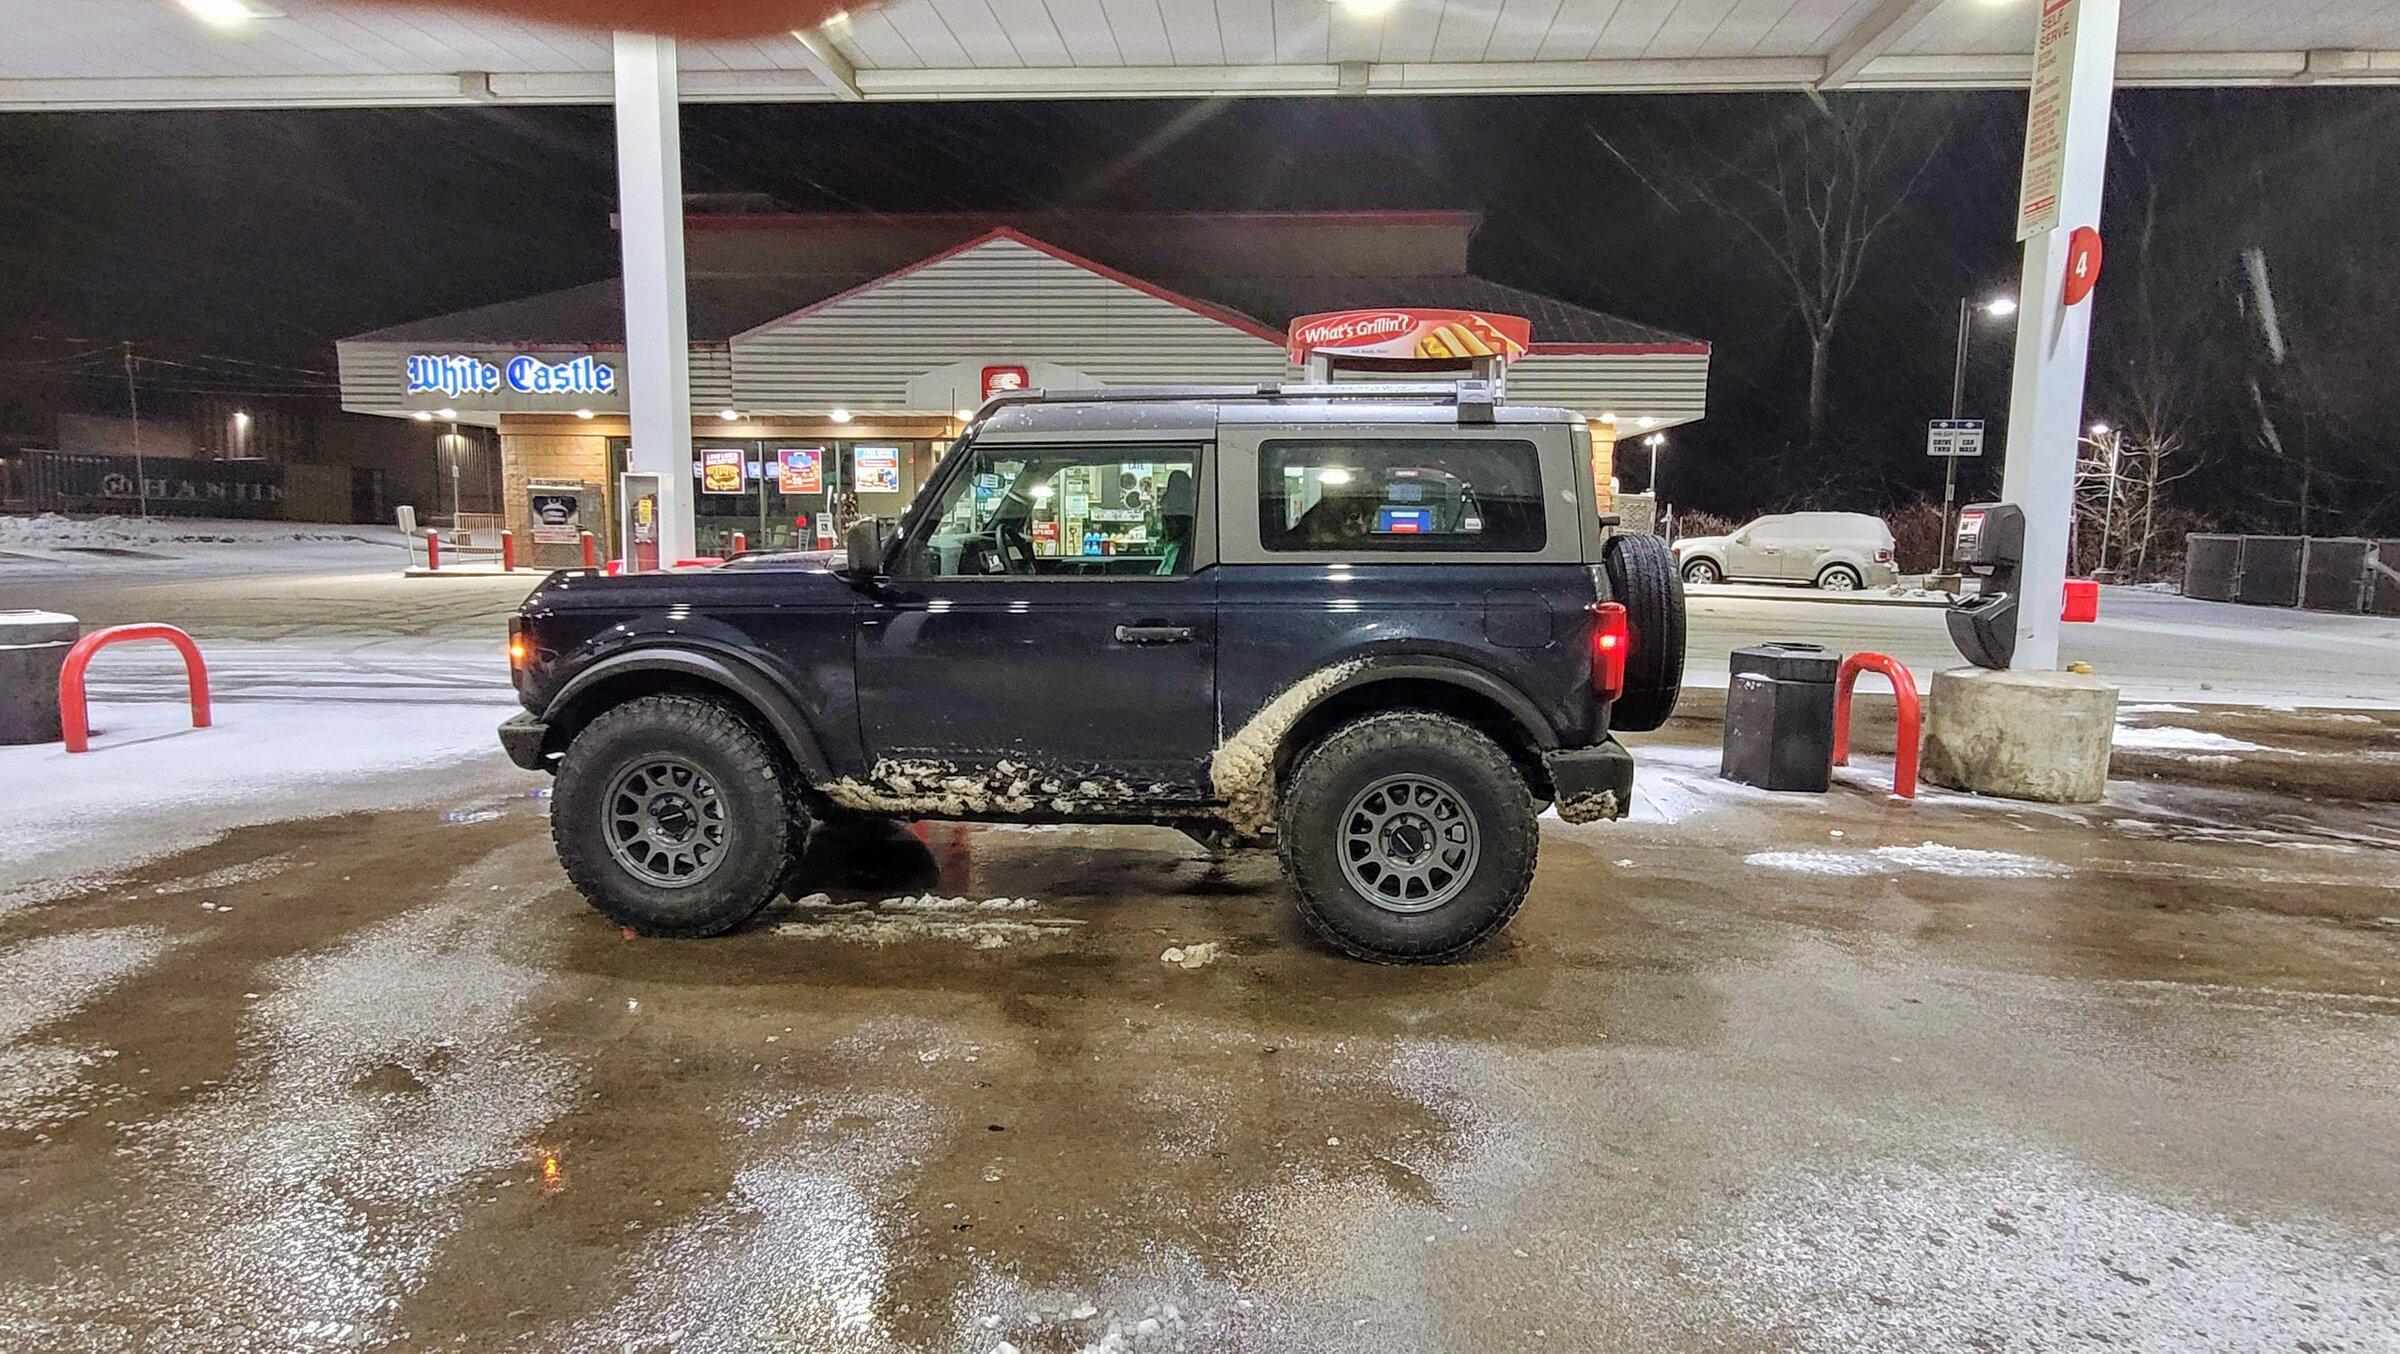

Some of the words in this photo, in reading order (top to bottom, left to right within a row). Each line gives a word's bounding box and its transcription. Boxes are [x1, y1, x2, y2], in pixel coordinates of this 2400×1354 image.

[2040, 21, 2070, 49] SERVE
[2041, 8, 2064, 33] SELF
[2075, 250, 2088, 279] 4
[1305, 323, 1354, 343] What's
[1356, 314, 1410, 337] Grillin'?
[406, 354, 500, 398] White
[506, 355, 614, 394] Castle
